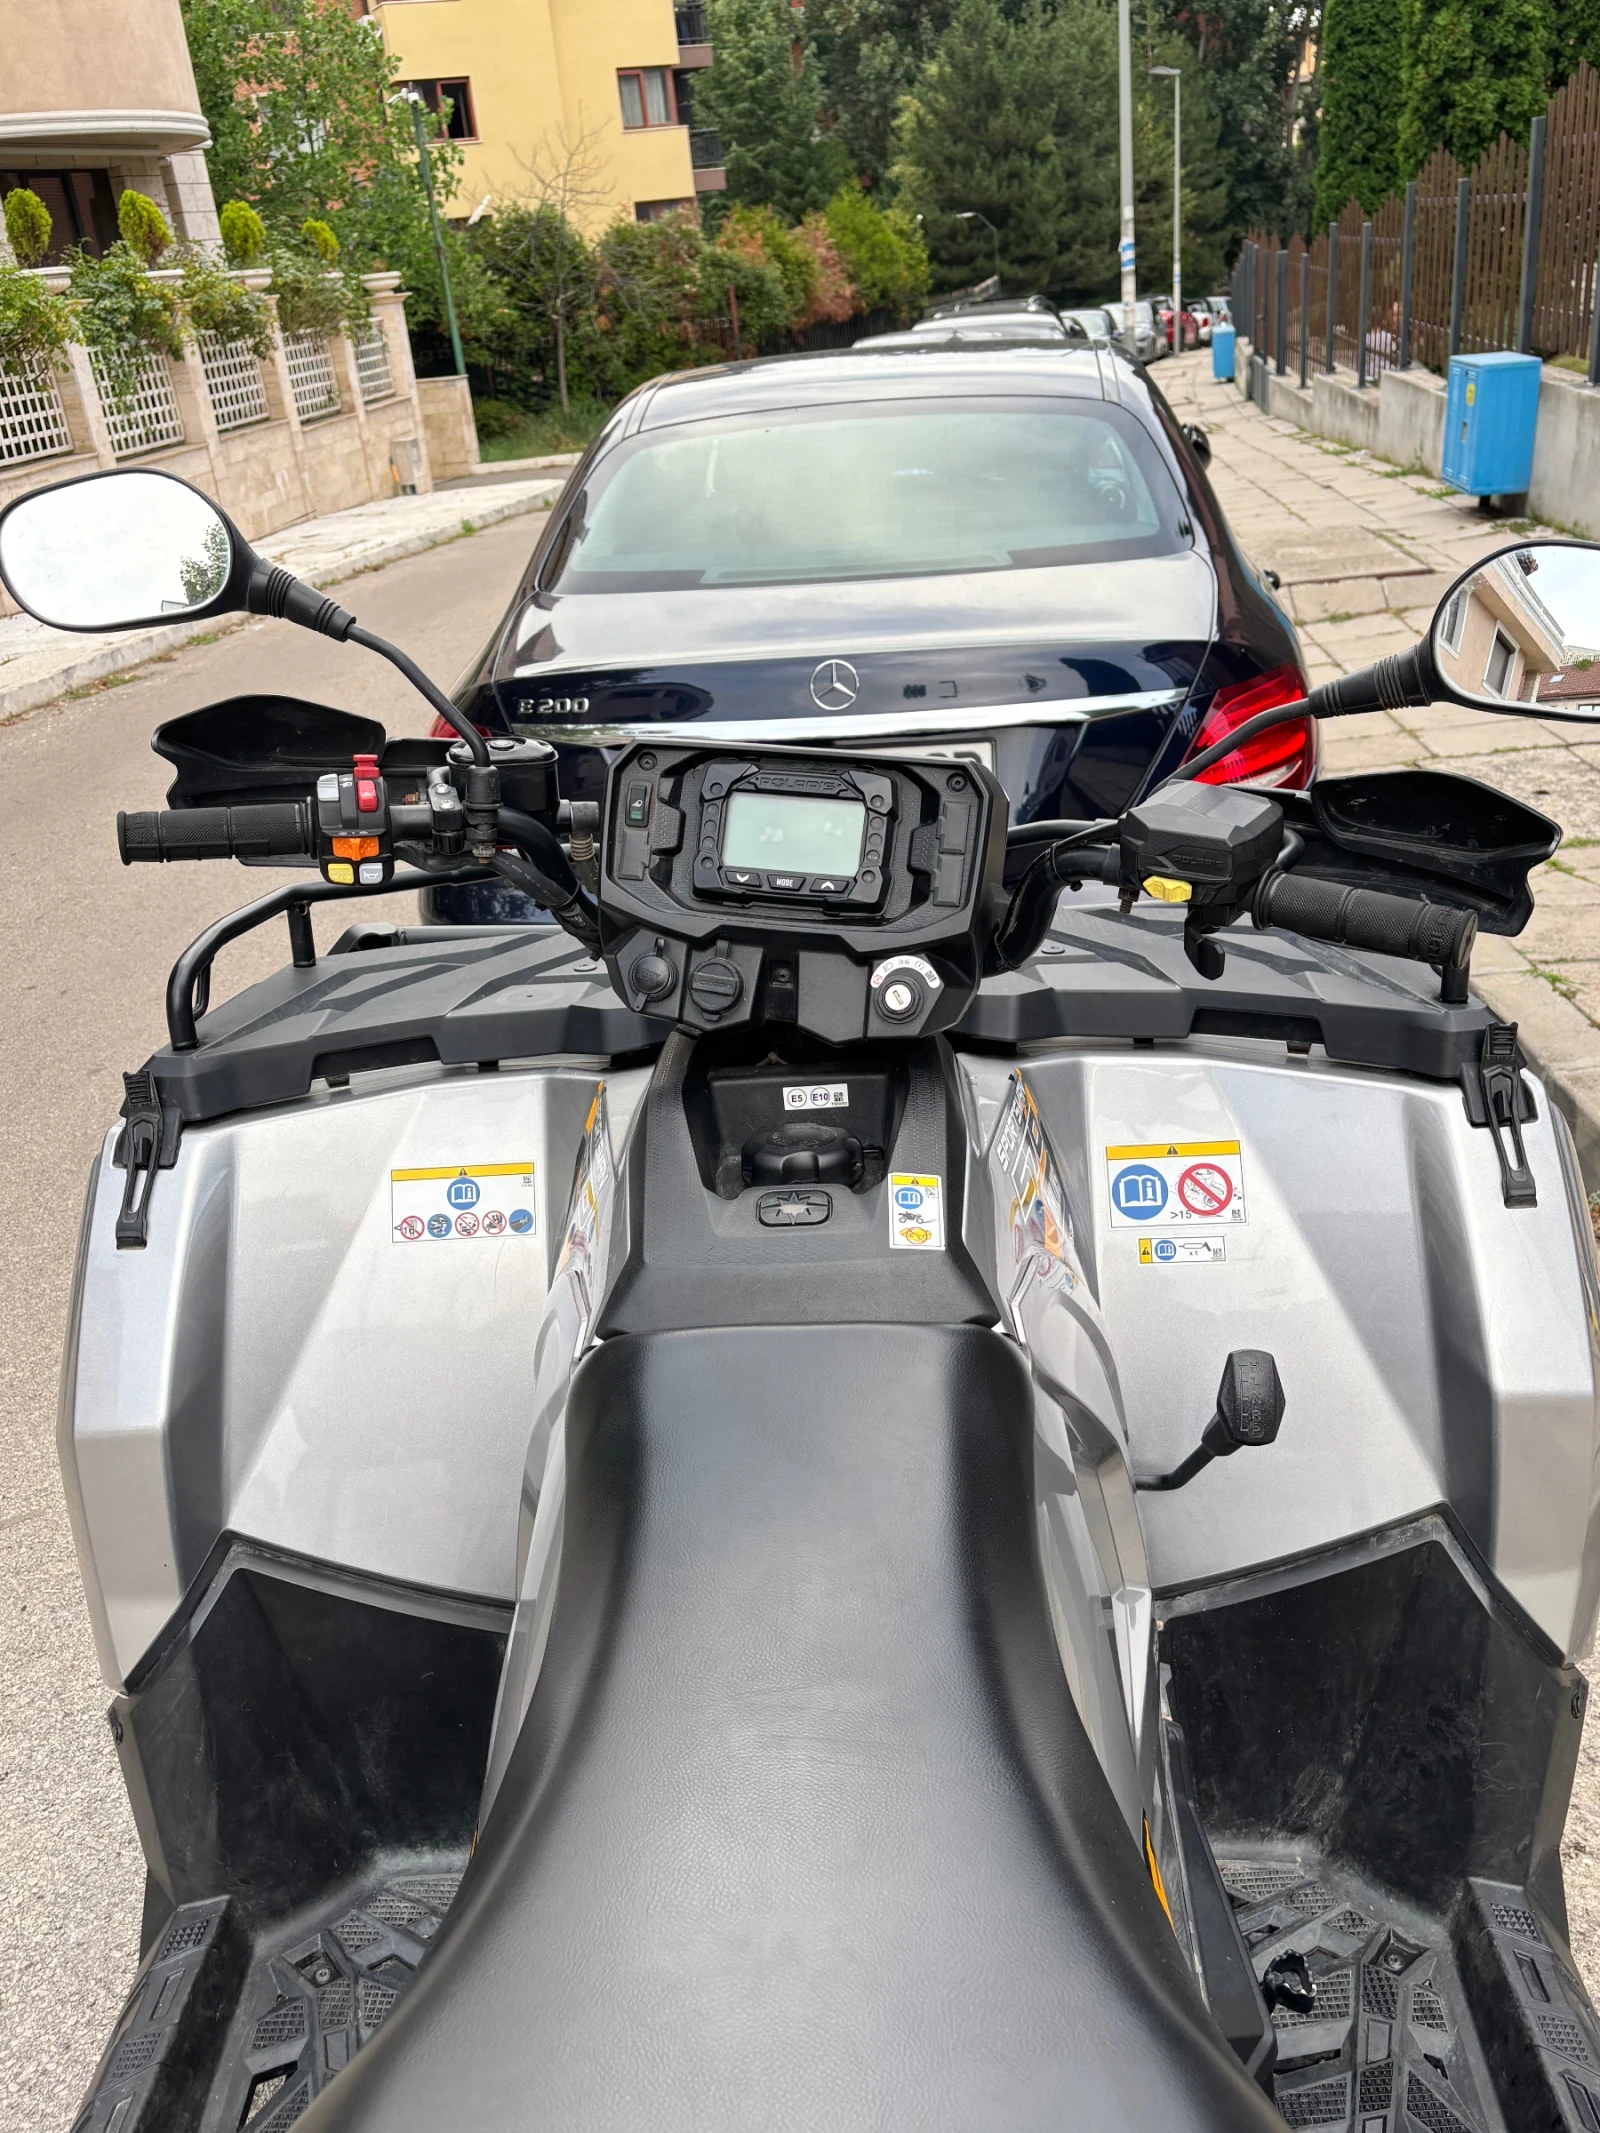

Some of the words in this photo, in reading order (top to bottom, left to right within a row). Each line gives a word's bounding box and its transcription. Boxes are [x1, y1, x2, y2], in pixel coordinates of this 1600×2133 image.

[517, 699, 533, 714] E
[537, 697, 590, 714] 200
[758, 776, 836, 791] POLARIS
[1171, 854, 1225, 869] POLARIS
[776, 877, 794, 888] MODE
[791, 1092, 803, 1103] E5
[812, 1090, 829, 1102] E10
[1252, 1410, 1261, 1420] R
[1252, 1426, 1261, 1436] P
